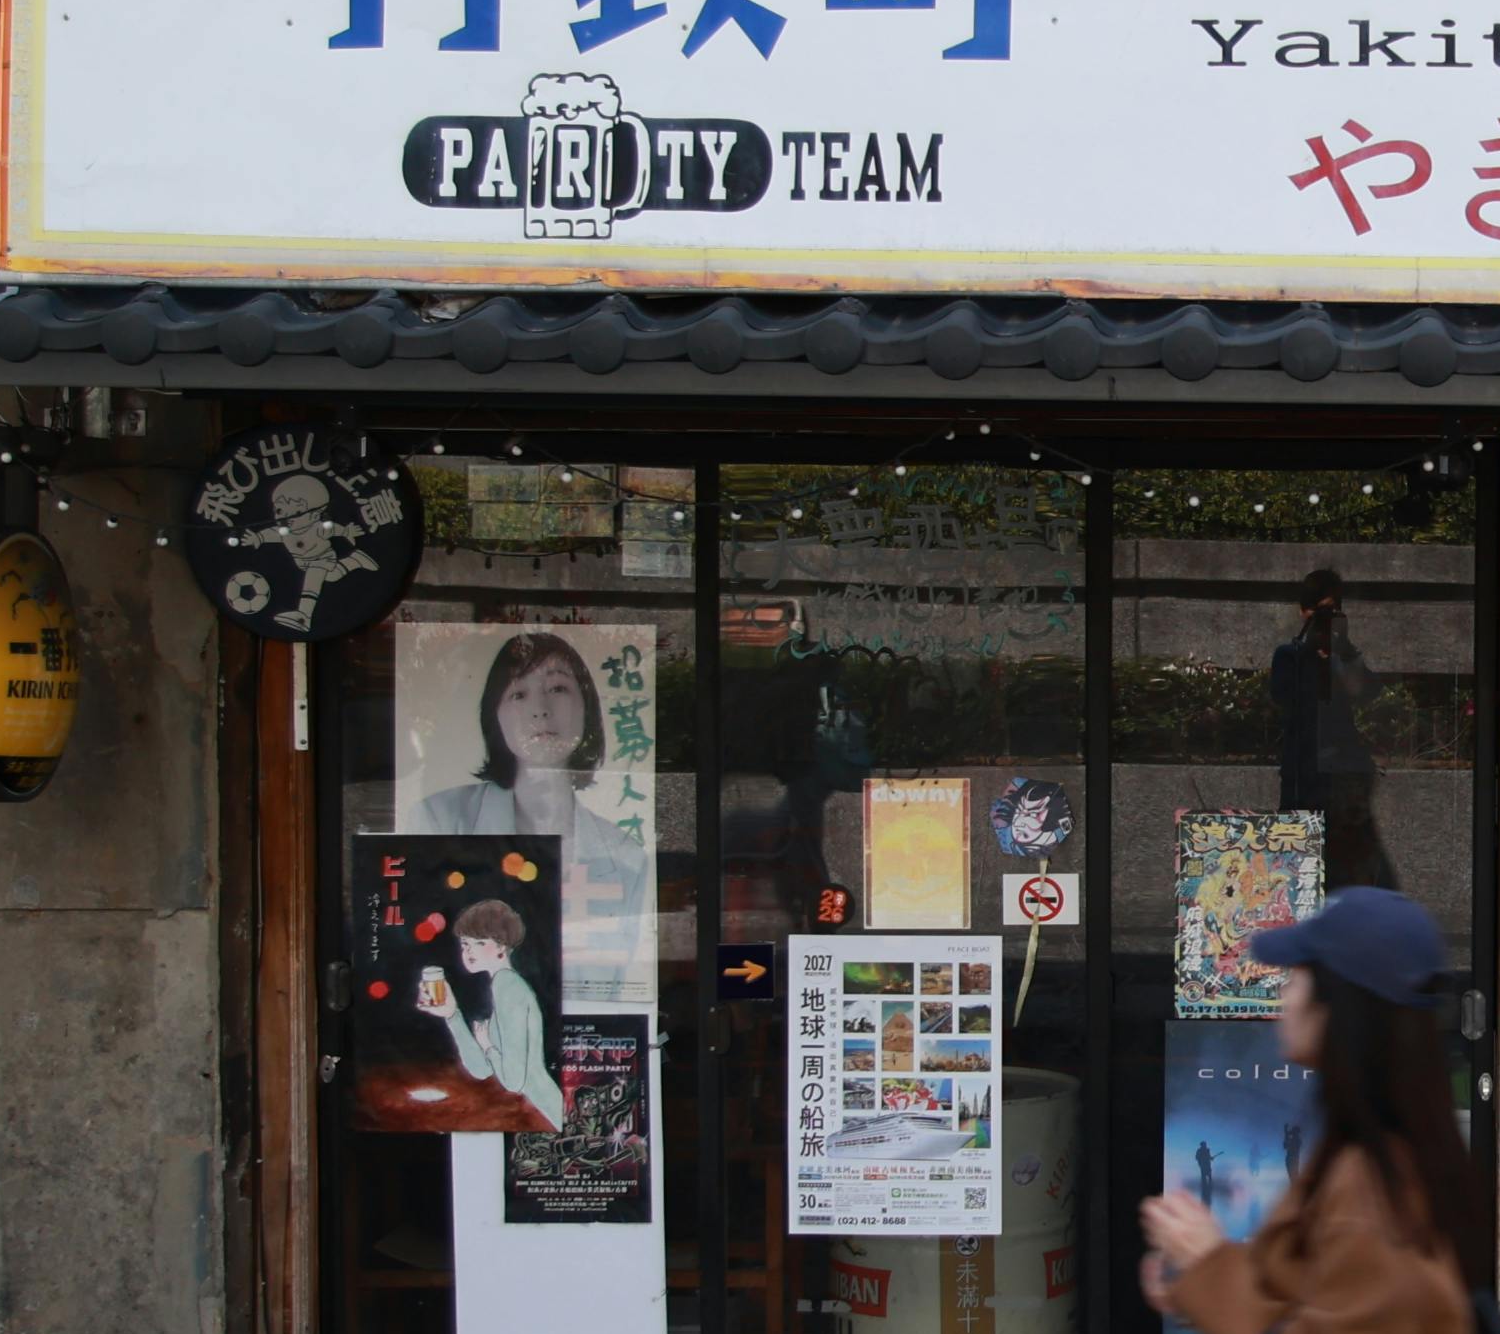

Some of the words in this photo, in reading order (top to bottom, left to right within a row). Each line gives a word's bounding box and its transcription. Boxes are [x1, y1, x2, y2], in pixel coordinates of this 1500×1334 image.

[782, 131, 944, 204] TEAM
[7, 679, 55, 700] KIRIN
[871, 783, 962, 808] downy
[381, 854, 407, 926] ビール
[947, 946, 970, 954] PEACE
[972, 946, 991, 954] BOAT
[804, 954, 832, 971] 2027
[799, 986, 826, 1158] 地球一周の船旅
[799, 1194, 816, 1209] 30
[837, 1217, 858, 1226] (02)
